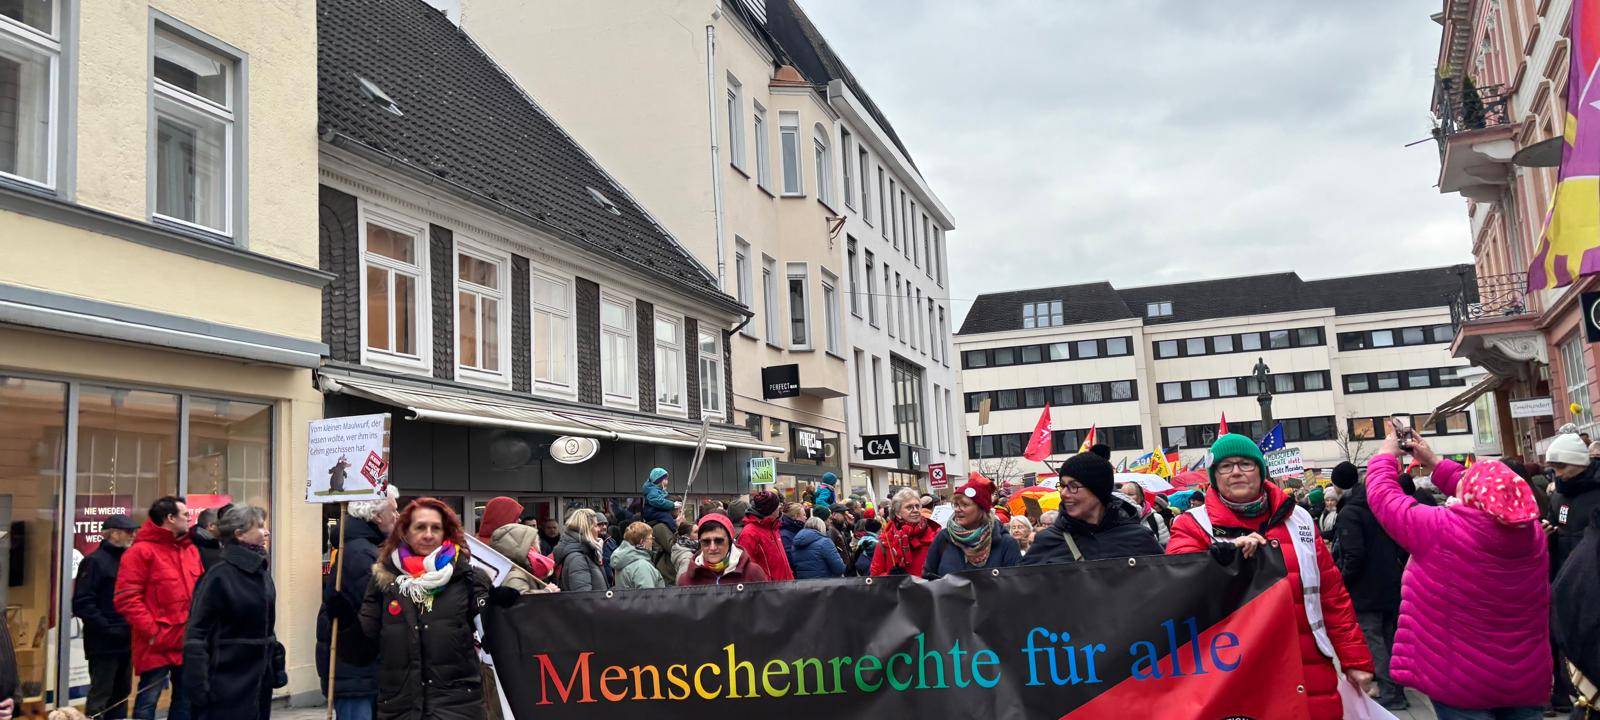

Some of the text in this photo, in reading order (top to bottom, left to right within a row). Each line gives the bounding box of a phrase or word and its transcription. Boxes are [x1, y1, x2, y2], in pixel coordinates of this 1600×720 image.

[769, 382, 790, 391] PERFECT
[311, 425, 323, 434] Vom
[323, 423, 342, 432] kleinen
[371, 419, 381, 428] der
[327, 434, 345, 443] wollte,
[358, 432, 369, 440] ihm
[369, 431, 378, 439] ins
[325, 445, 355, 456] geschissen
[867, 439, 895, 455] C&A
[1268, 458, 1286, 466] RECHTE
[752, 470, 773, 480] Nails
[84, 507, 126, 515] NIE WIEDER
[532, 616, 1243, 706] Menschenrechte für alle
